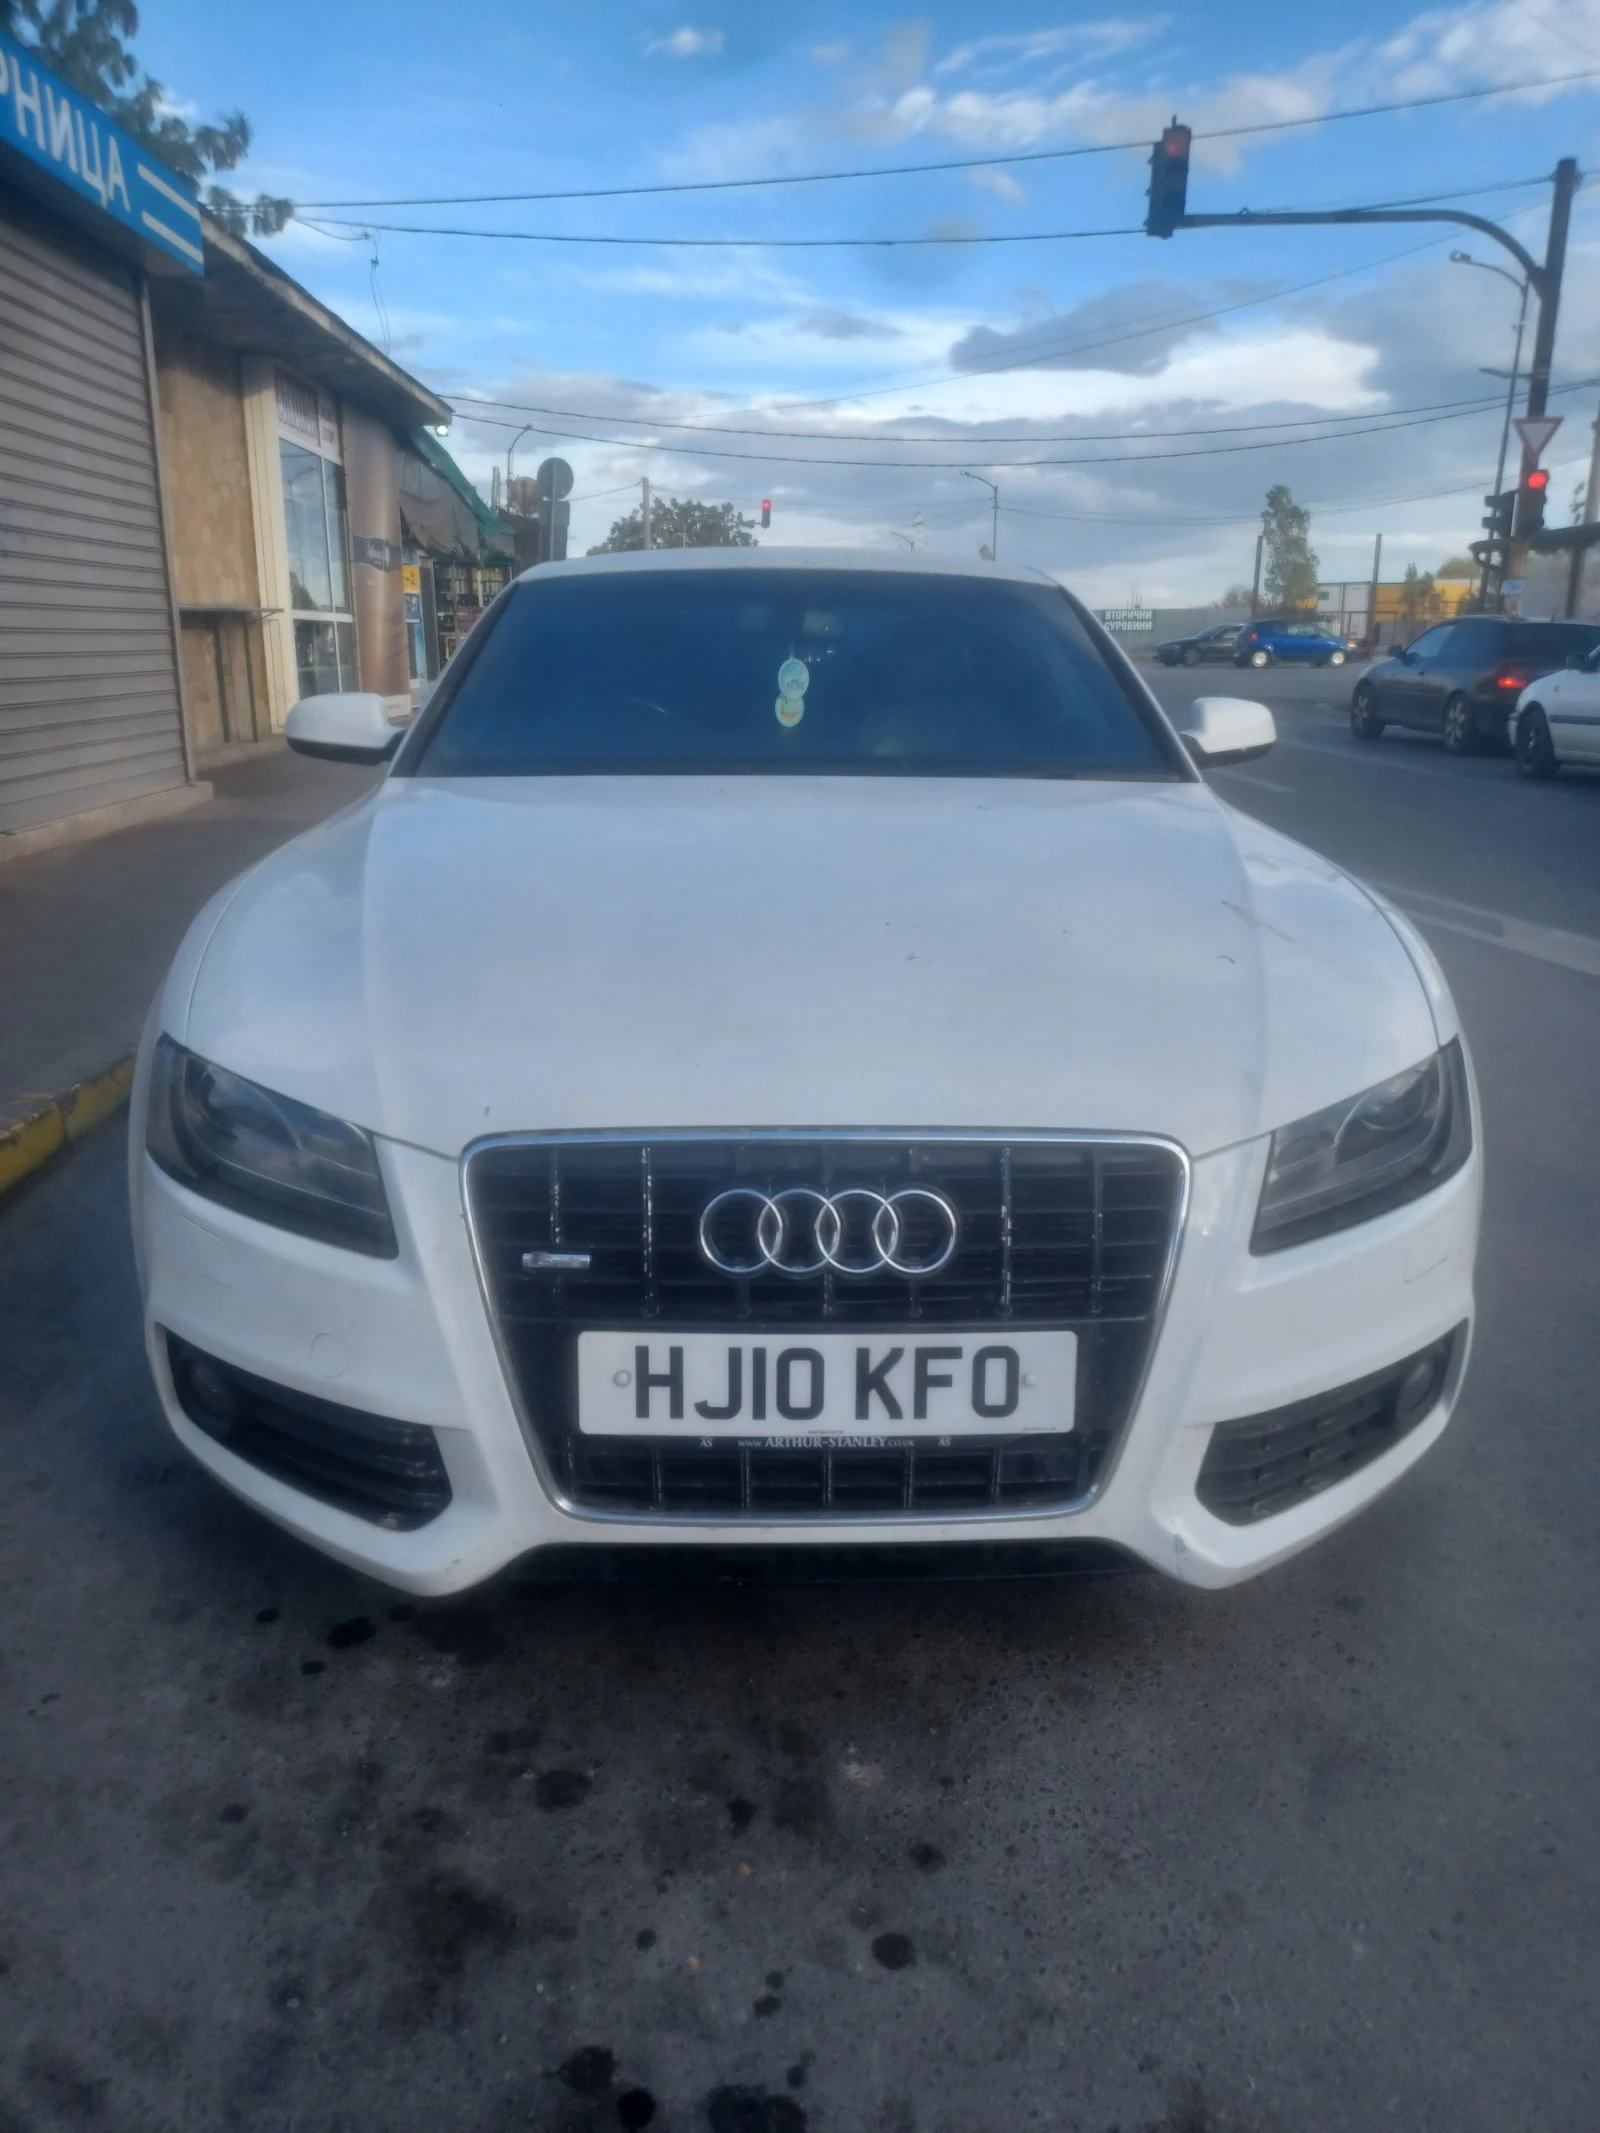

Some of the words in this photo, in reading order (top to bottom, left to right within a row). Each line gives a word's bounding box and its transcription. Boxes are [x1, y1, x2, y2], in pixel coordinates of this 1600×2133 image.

[1105, 610, 1153, 620] ВТОРИЧНИ
[1104, 620, 1153, 631] СУРОВИНИ
[855, 1345, 1020, 1420] KFO
